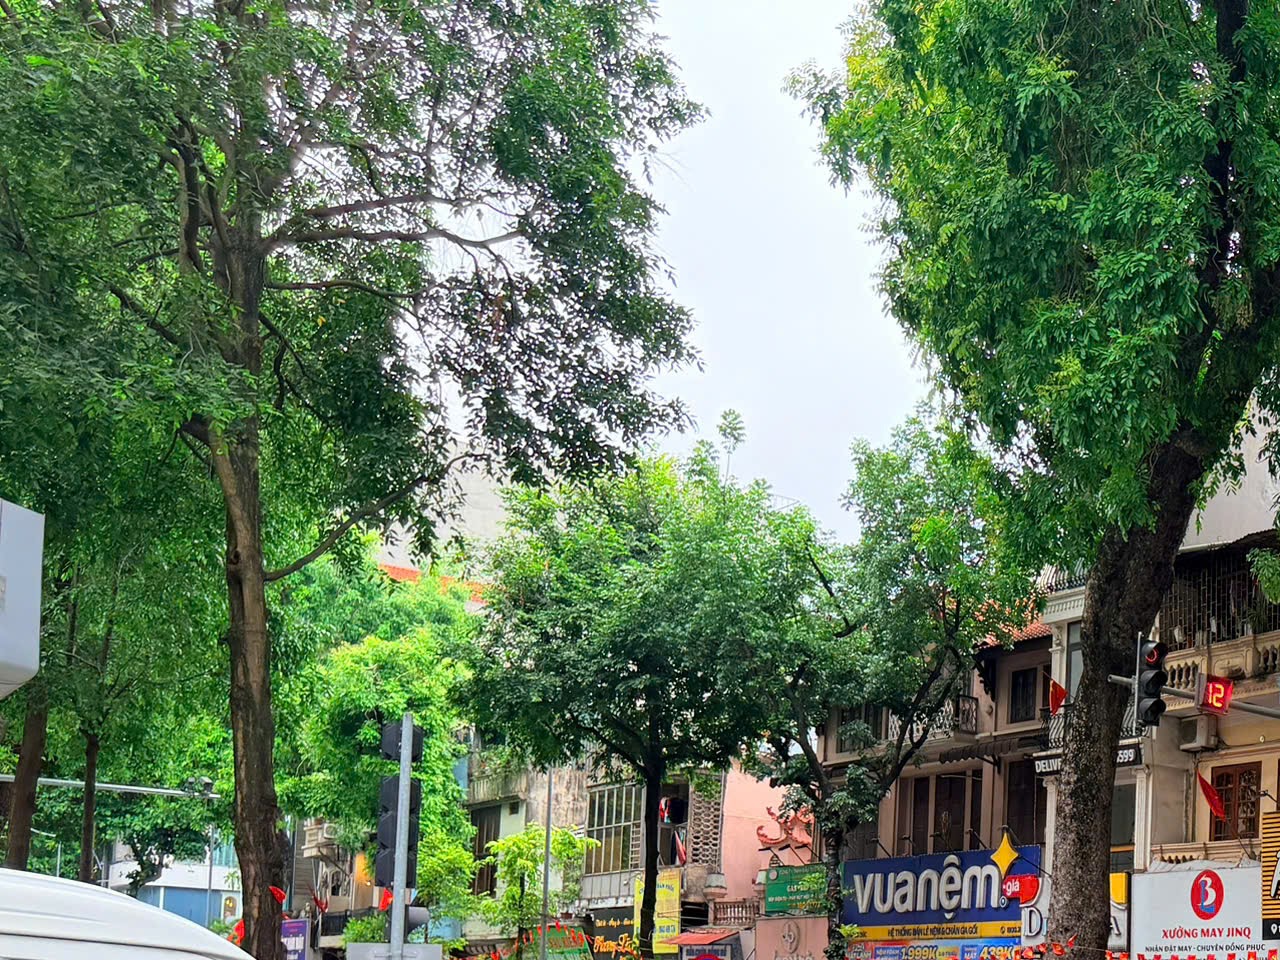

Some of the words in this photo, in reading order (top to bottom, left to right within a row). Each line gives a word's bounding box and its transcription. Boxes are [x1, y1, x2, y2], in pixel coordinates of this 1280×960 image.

[1208, 682, 1225, 708] 12
[1161, 926, 1199, 939] XƯỞNG
[1200, 927, 1225, 938] MAY
[1226, 926, 1252, 939] JINQ
[1196, 942, 1225, 952] CHUYÊN
[1225, 941, 1246, 952] ĐỒNG
[1246, 943, 1266, 953] PHỤC
